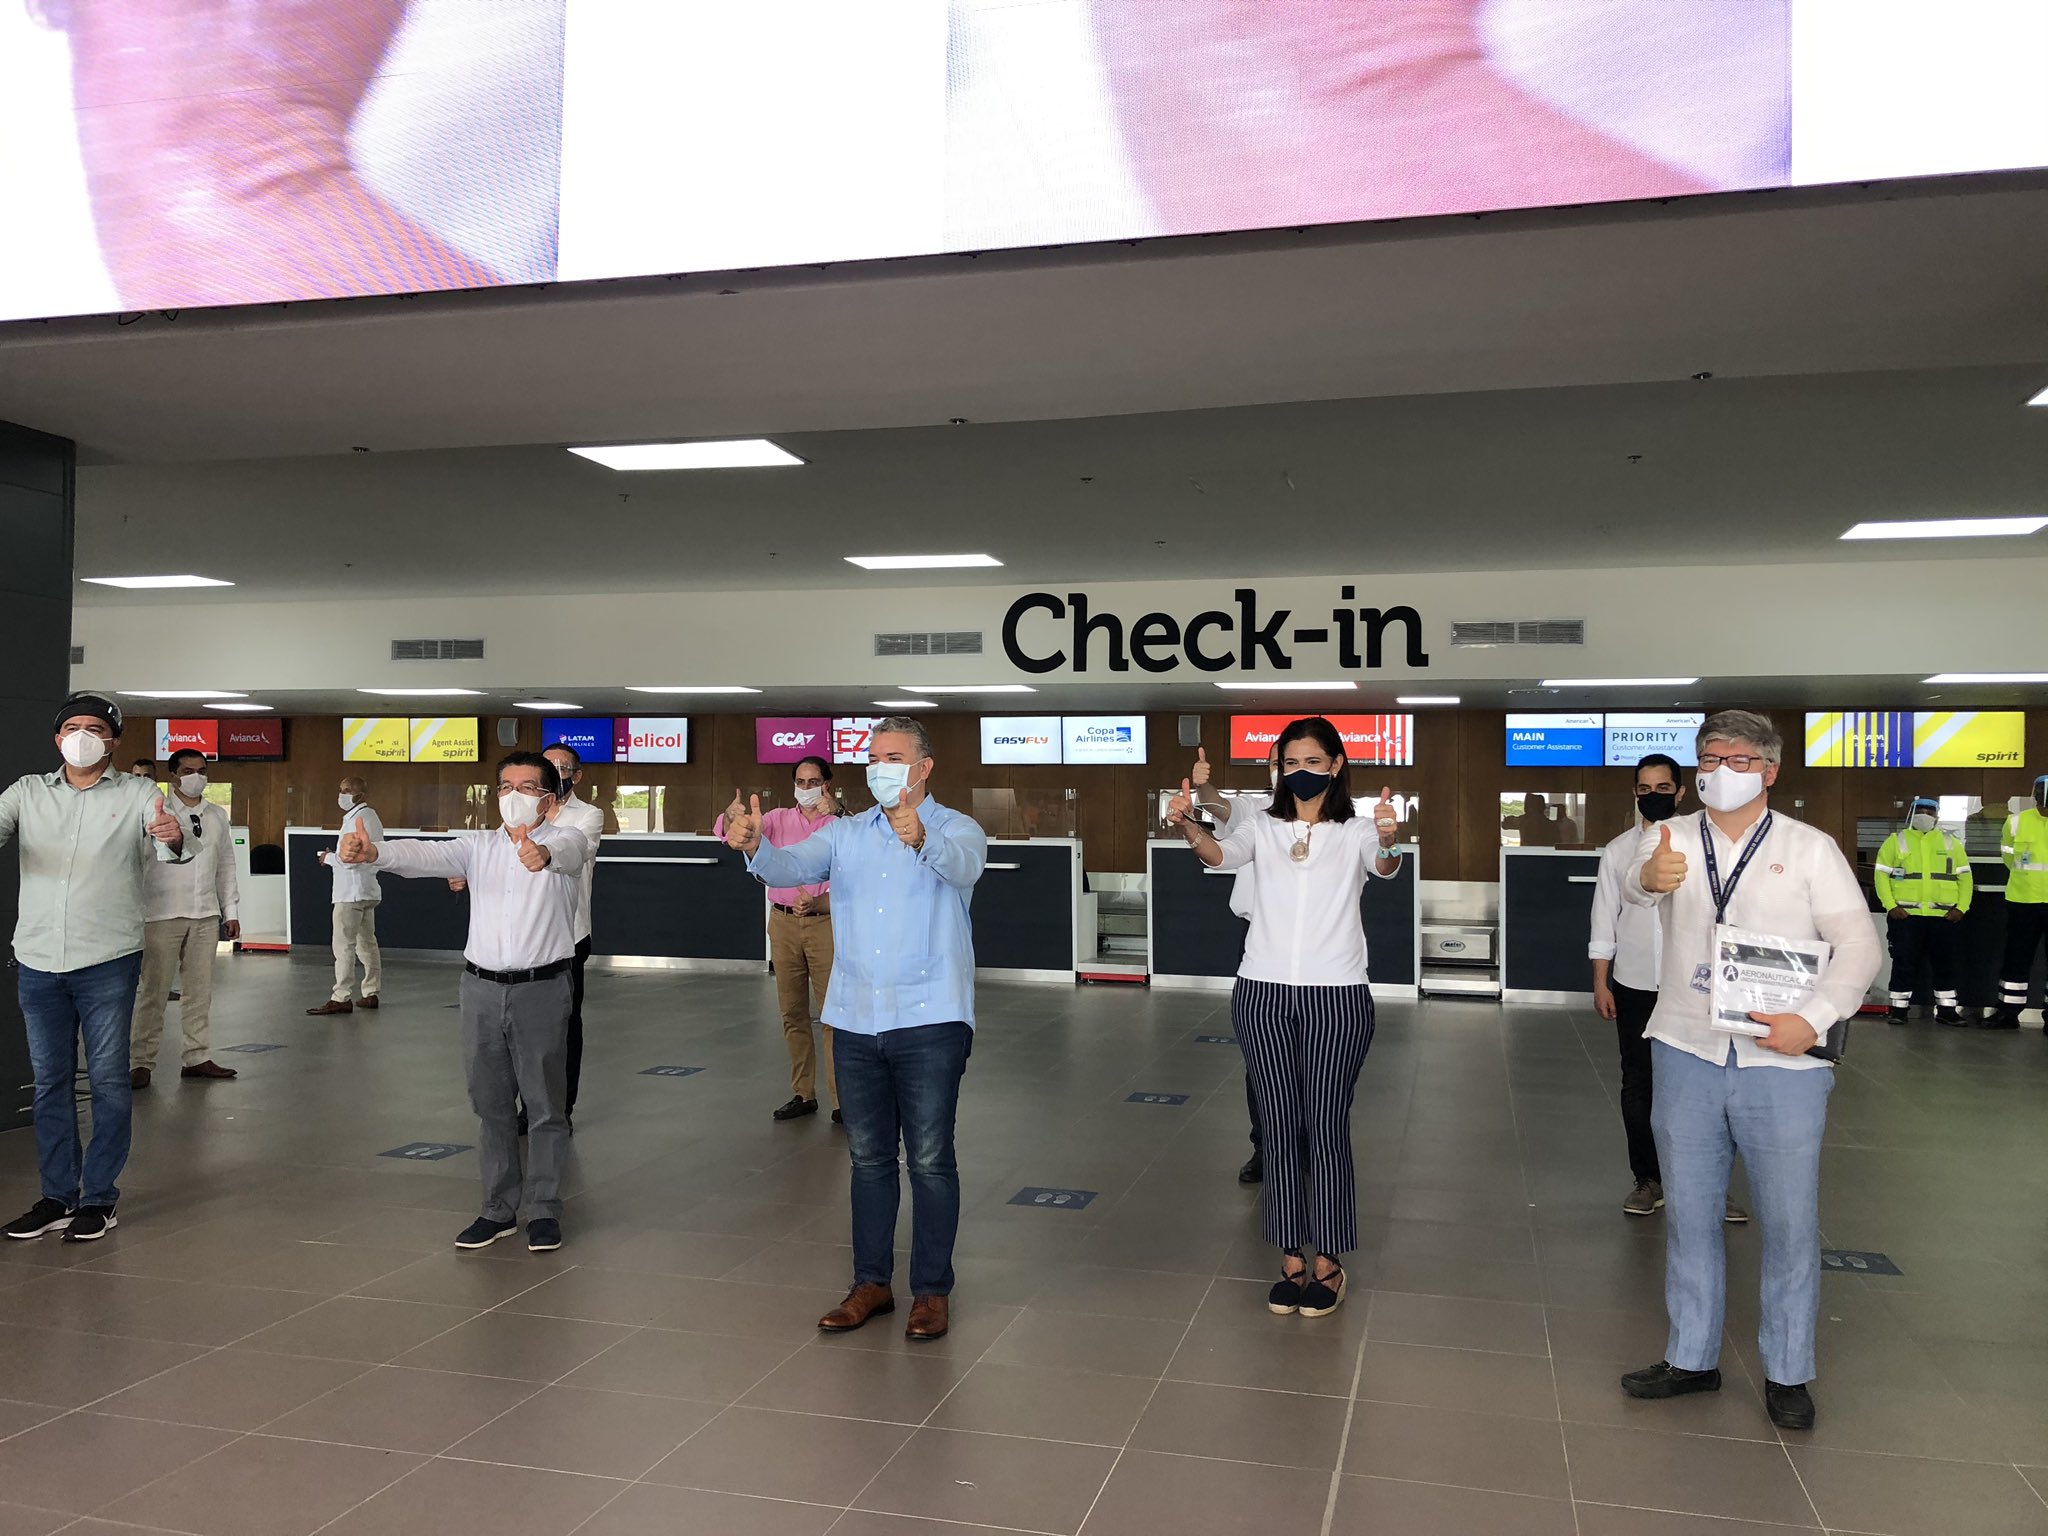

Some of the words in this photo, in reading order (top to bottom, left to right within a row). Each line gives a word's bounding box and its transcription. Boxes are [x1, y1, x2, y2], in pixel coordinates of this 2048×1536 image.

[1001, 585, 1429, 673] Check-in
[1087, 727, 1115, 735] Copa
[166, 732, 197, 743] Avianca
[229, 733, 261, 742] Avianca
[772, 732, 805, 747] GCA
[993, 736, 1049, 745] EASYFLY
[1075, 735, 1115, 743] Airlines
[1512, 732, 1545, 741] MAIN
[1612, 732, 1678, 742] PRIORITY
[432, 739, 453, 748] Agent
[1512, 743, 1546, 751] Customer
[1546, 743, 1583, 751] Assistance
[442, 748, 474, 759] spirit
[1976, 751, 2020, 763] spirit
